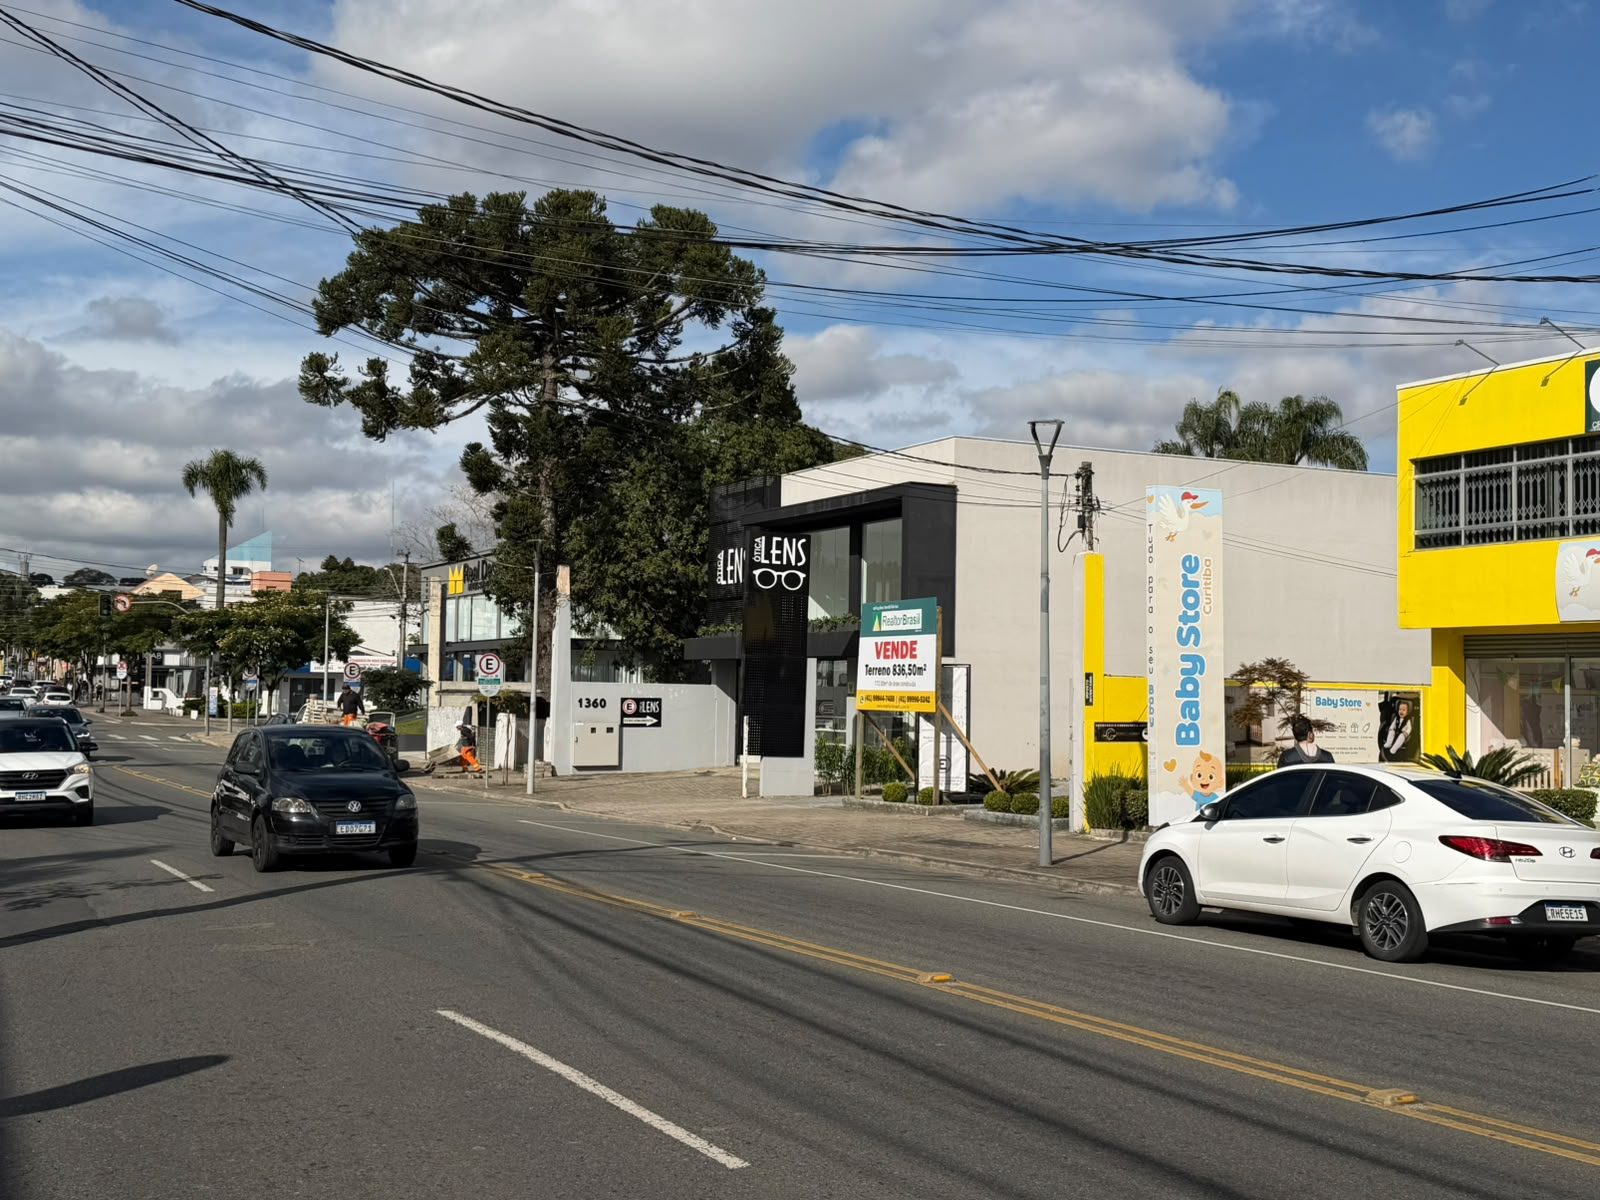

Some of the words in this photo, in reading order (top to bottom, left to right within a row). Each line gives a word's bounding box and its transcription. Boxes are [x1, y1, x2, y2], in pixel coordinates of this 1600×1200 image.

[752, 536, 762, 563] ÓTICA
[760, 535, 807, 567] LENS
[1202, 558, 1212, 615] Curitiba
[1176, 554, 1201, 648] Store
[1147, 626, 1154, 634] o
[874, 640, 918, 660] VENDE
[486, 658, 494, 670] E
[864, 664, 891, 676] Terreno
[892, 663, 927, 678] 836,50m²
[349, 666, 356, 676] E
[578, 697, 607, 709] 1360
[1175, 653, 1206, 746] Baby
[1315, 696, 1338, 708] Baby
[1339, 697, 1362, 708] Store
[642, 701, 660, 713] LENS
[1550, 908, 1585, 920] RHE5E15
